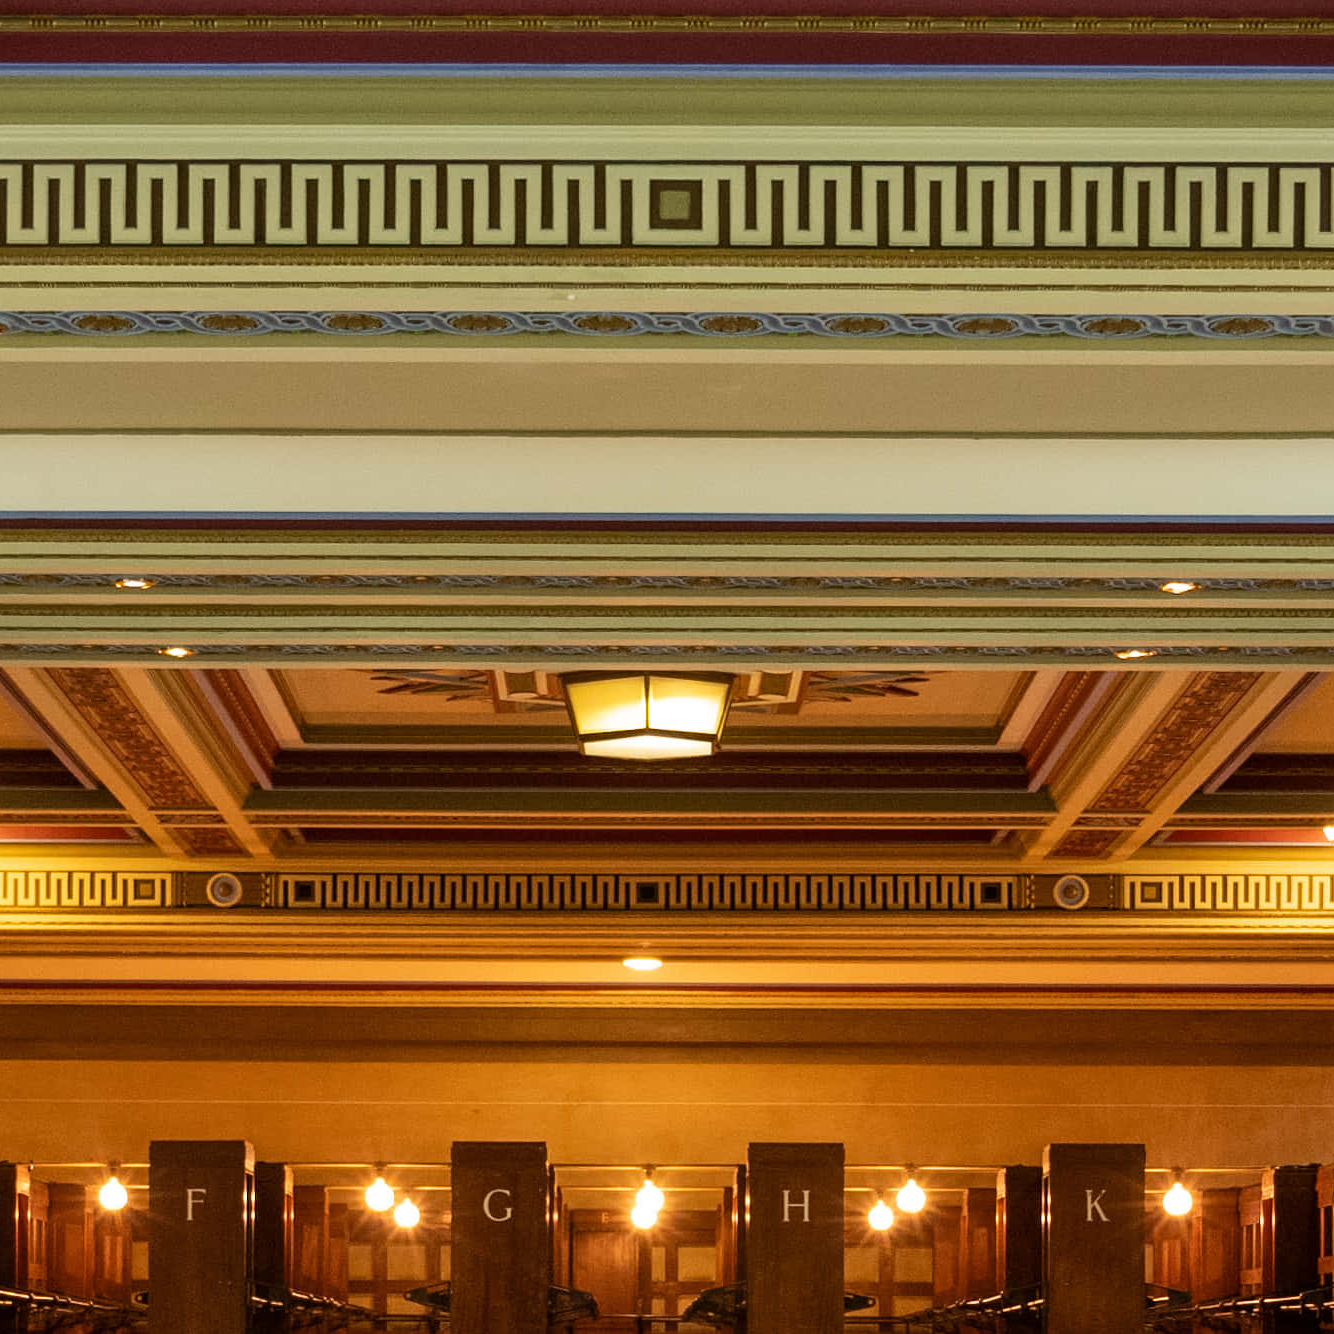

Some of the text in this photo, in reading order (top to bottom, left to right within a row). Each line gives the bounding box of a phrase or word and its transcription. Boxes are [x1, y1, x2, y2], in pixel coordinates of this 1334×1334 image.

[186, 1188, 207, 1221] F
[483, 1188, 513, 1222] G
[782, 1189, 811, 1223] H
[1085, 1189, 1110, 1222] K
